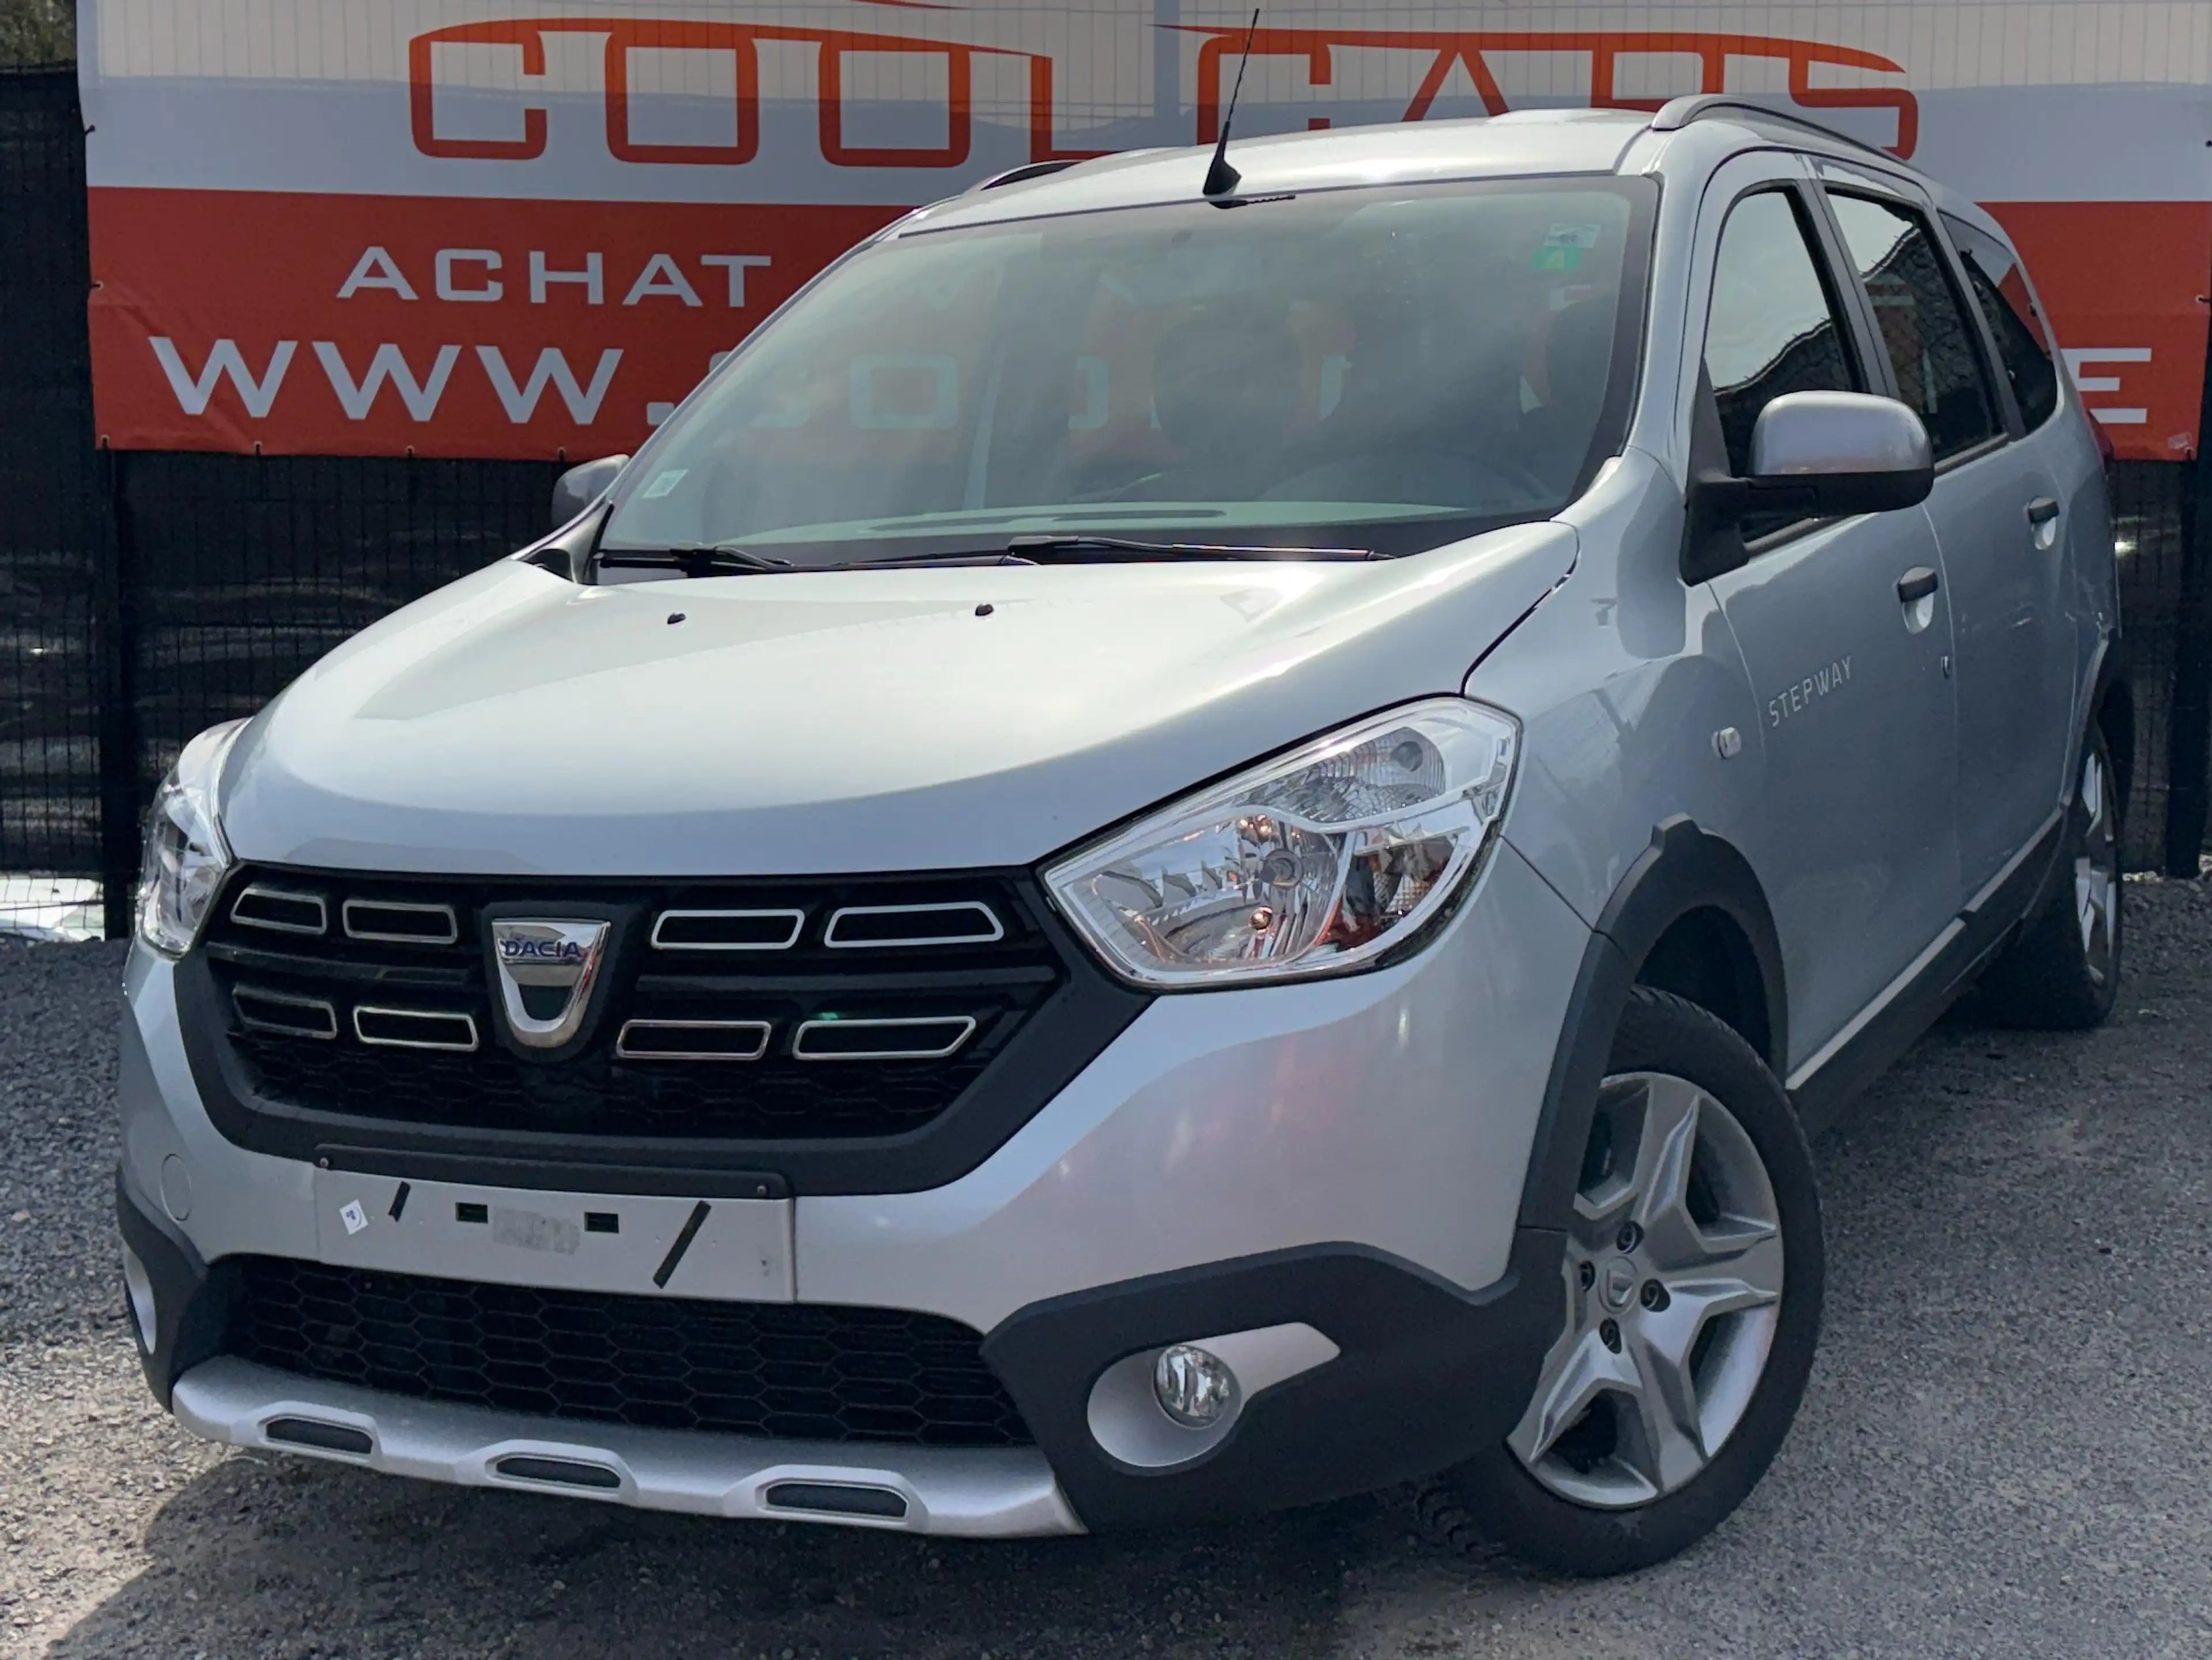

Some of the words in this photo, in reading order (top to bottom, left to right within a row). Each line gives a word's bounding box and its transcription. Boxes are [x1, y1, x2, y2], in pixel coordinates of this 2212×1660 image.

[409, 17, 1128, 168] COOL
[337, 246, 772, 308] ACHAT
[1768, 655, 1851, 727] STEPWAY
[504, 940, 583, 957] DACIA
